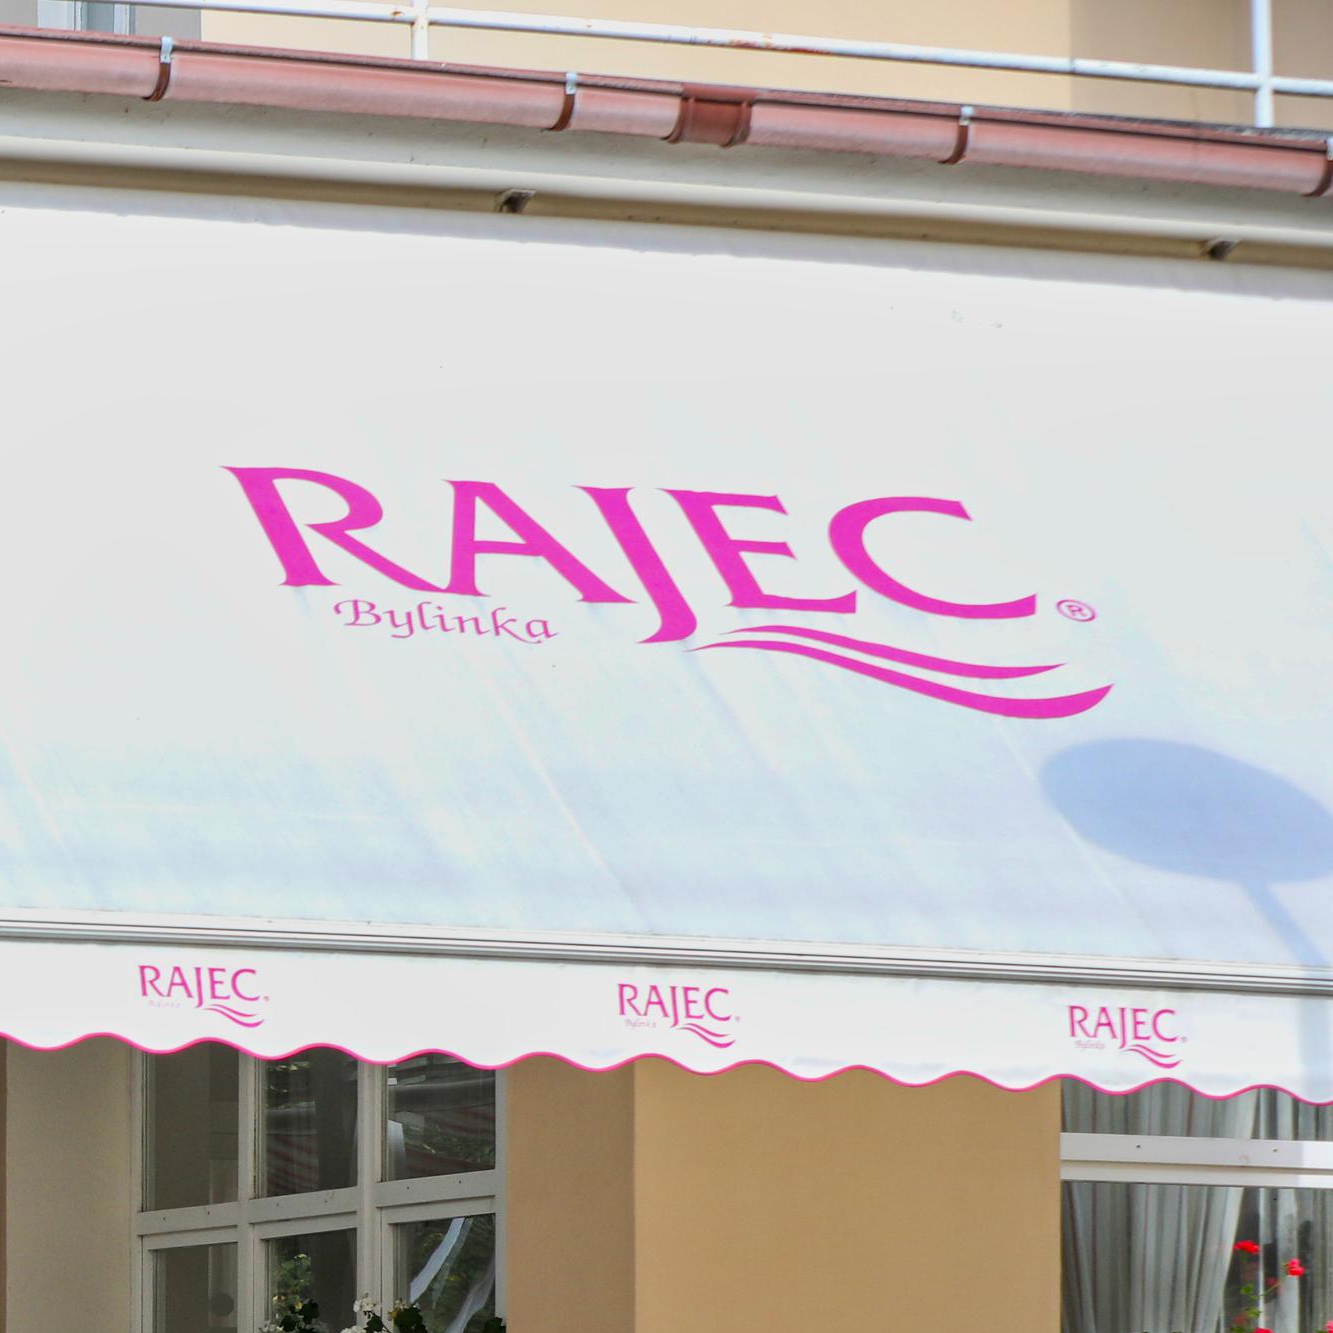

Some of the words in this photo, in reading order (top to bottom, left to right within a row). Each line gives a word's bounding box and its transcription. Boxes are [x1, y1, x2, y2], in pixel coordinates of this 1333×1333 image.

[219, 466, 1038, 643] RAJEC
[333, 599, 558, 644] Bylinka
[138, 965, 260, 1008] RAJEC
[618, 983, 731, 1028] RAJEC
[1067, 1005, 1177, 1049] RAJEC
